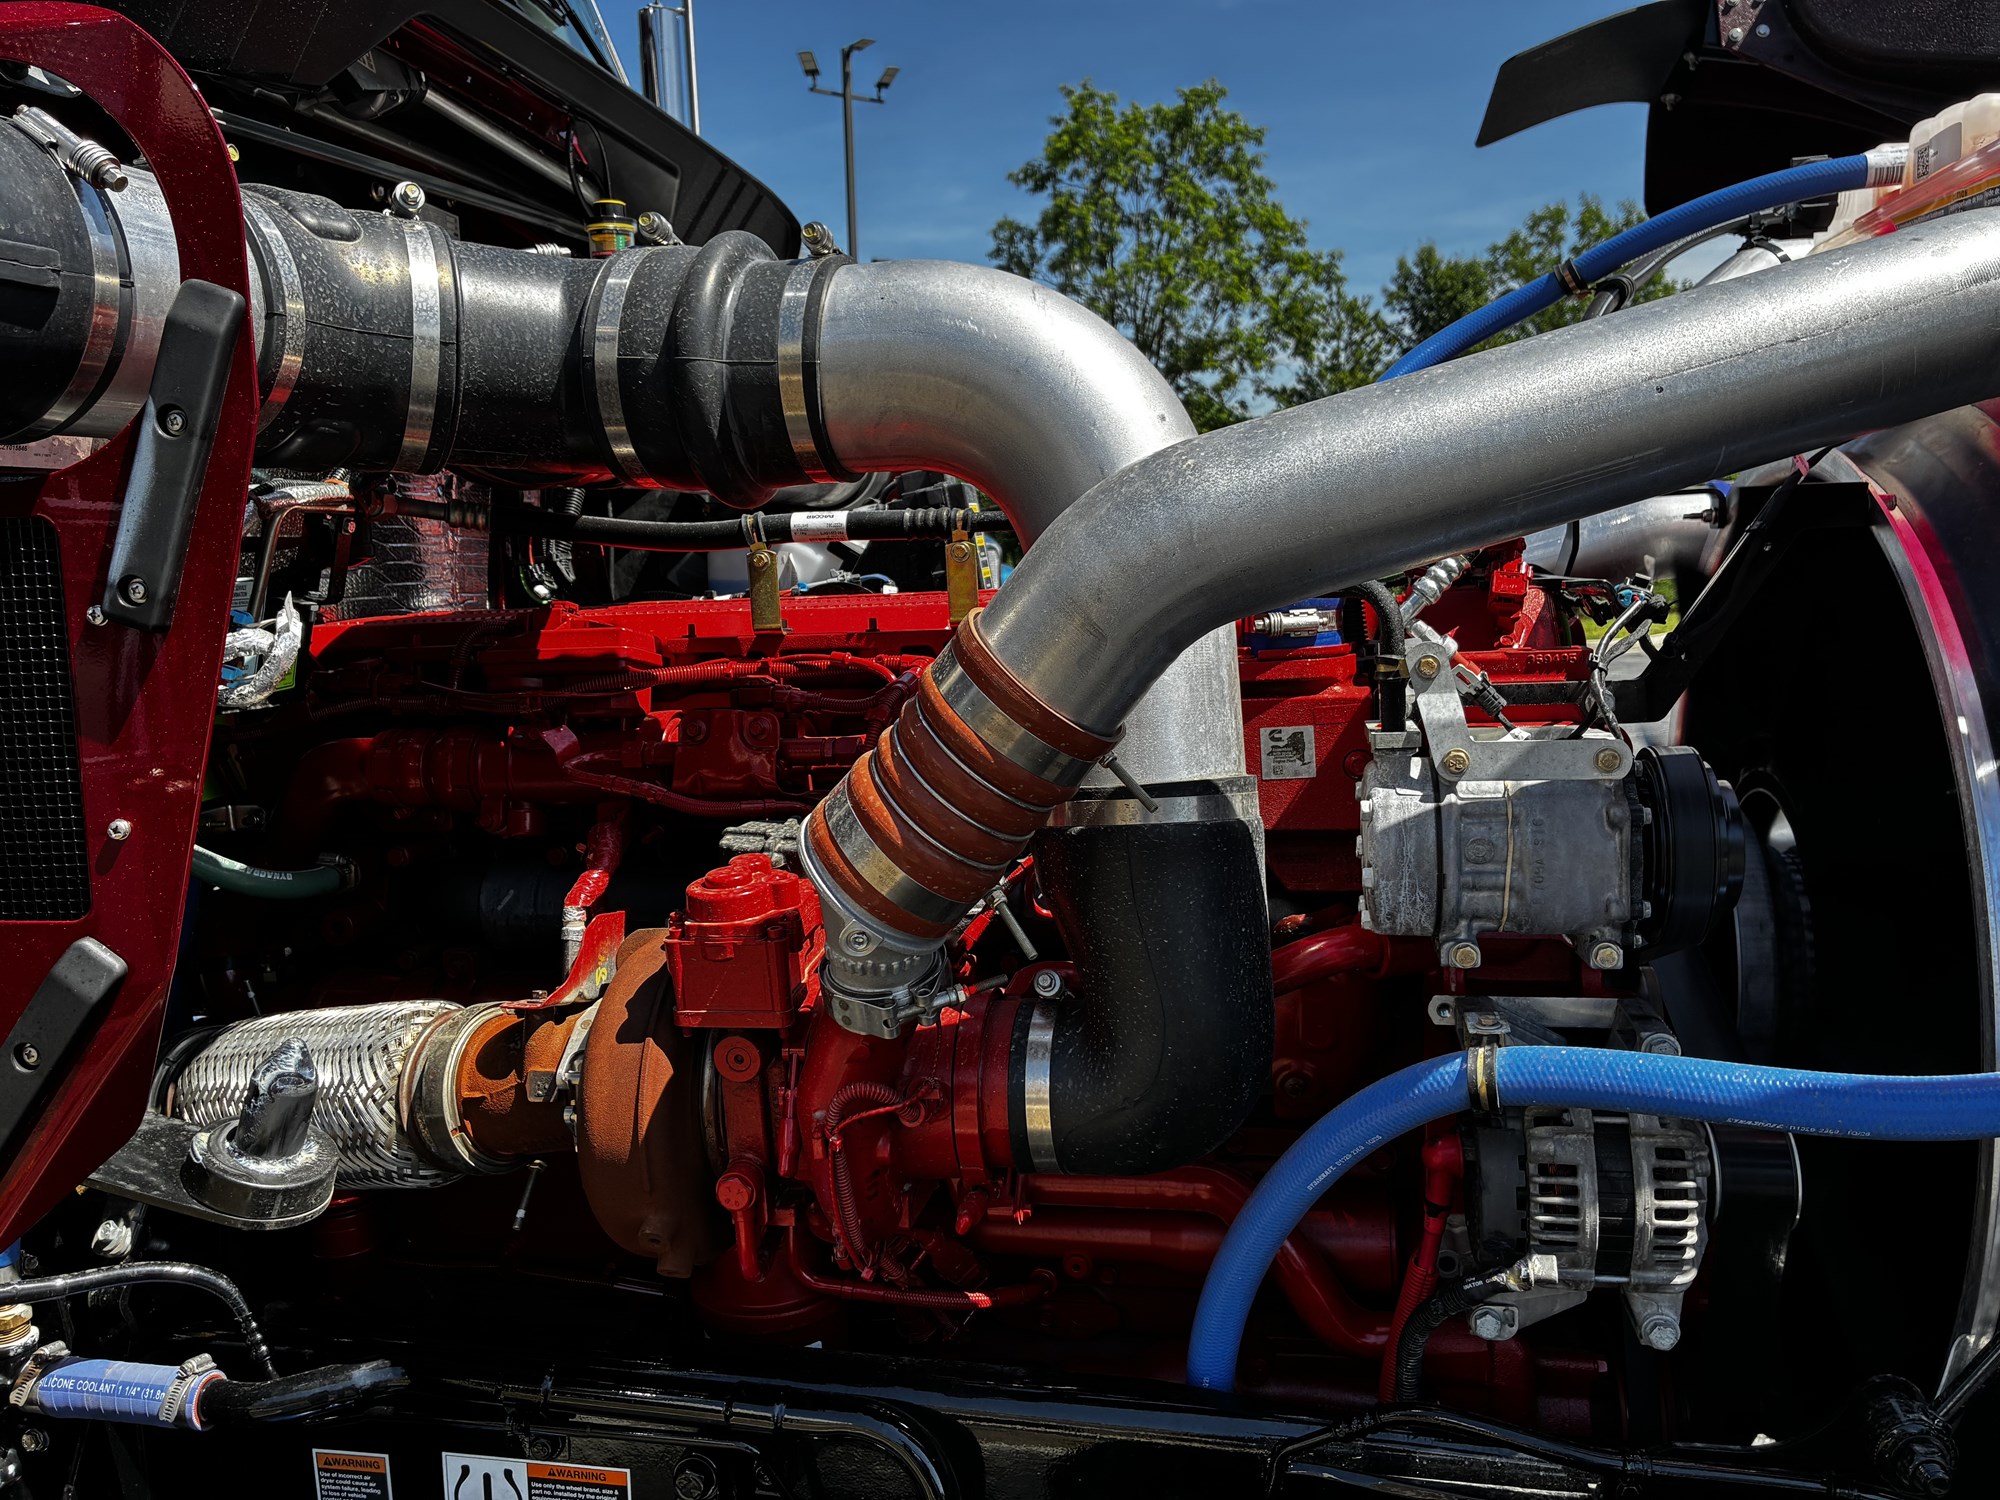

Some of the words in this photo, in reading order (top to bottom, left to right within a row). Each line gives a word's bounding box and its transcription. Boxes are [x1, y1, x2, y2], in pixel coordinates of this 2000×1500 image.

[39, 1377, 75, 1390] SILICONE
[76, 1380, 116, 1394] COOLANT
[118, 1386, 122, 1394] 1
[331, 1457, 380, 1470] WARNING
[338, 1472, 363, 1480] incorrect
[556, 1468, 607, 1481] WARNING
[360, 1487, 381, 1495] leading
[543, 1482, 555, 1490] only
[583, 1486, 601, 1494] brand,
[553, 1490, 577, 1498] installed
